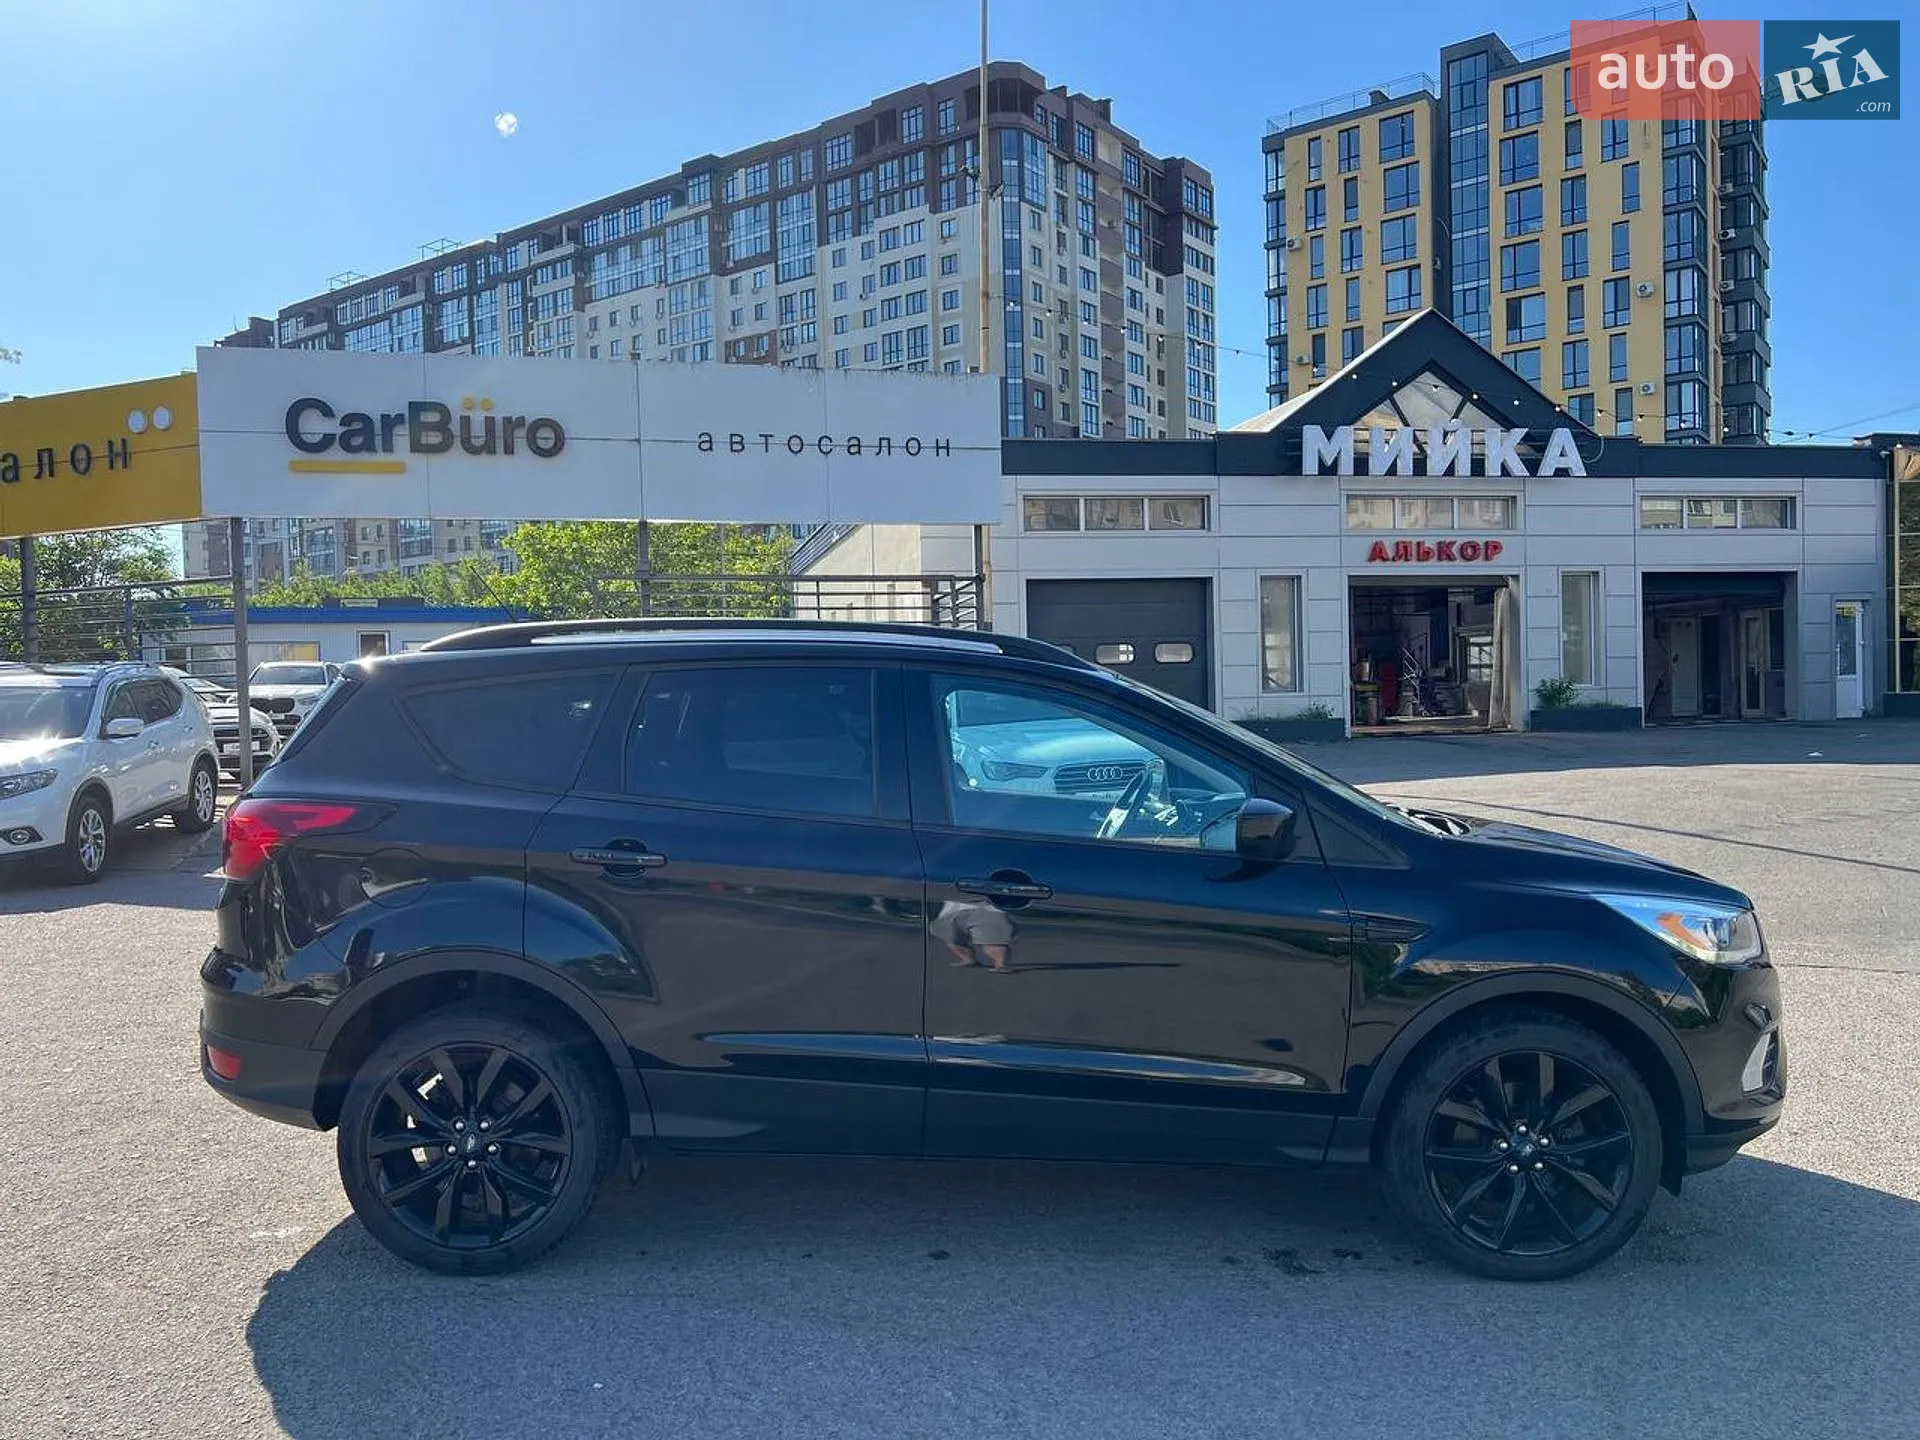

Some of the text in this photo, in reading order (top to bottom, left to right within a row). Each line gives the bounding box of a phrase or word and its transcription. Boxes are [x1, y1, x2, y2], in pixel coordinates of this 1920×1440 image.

[285, 397, 566, 458] CarBüro
[697, 431, 951, 457] автосалон
[1302, 419, 1588, 477] МИЙКА
[1367, 539, 1504, 562] АЛЬКОР
